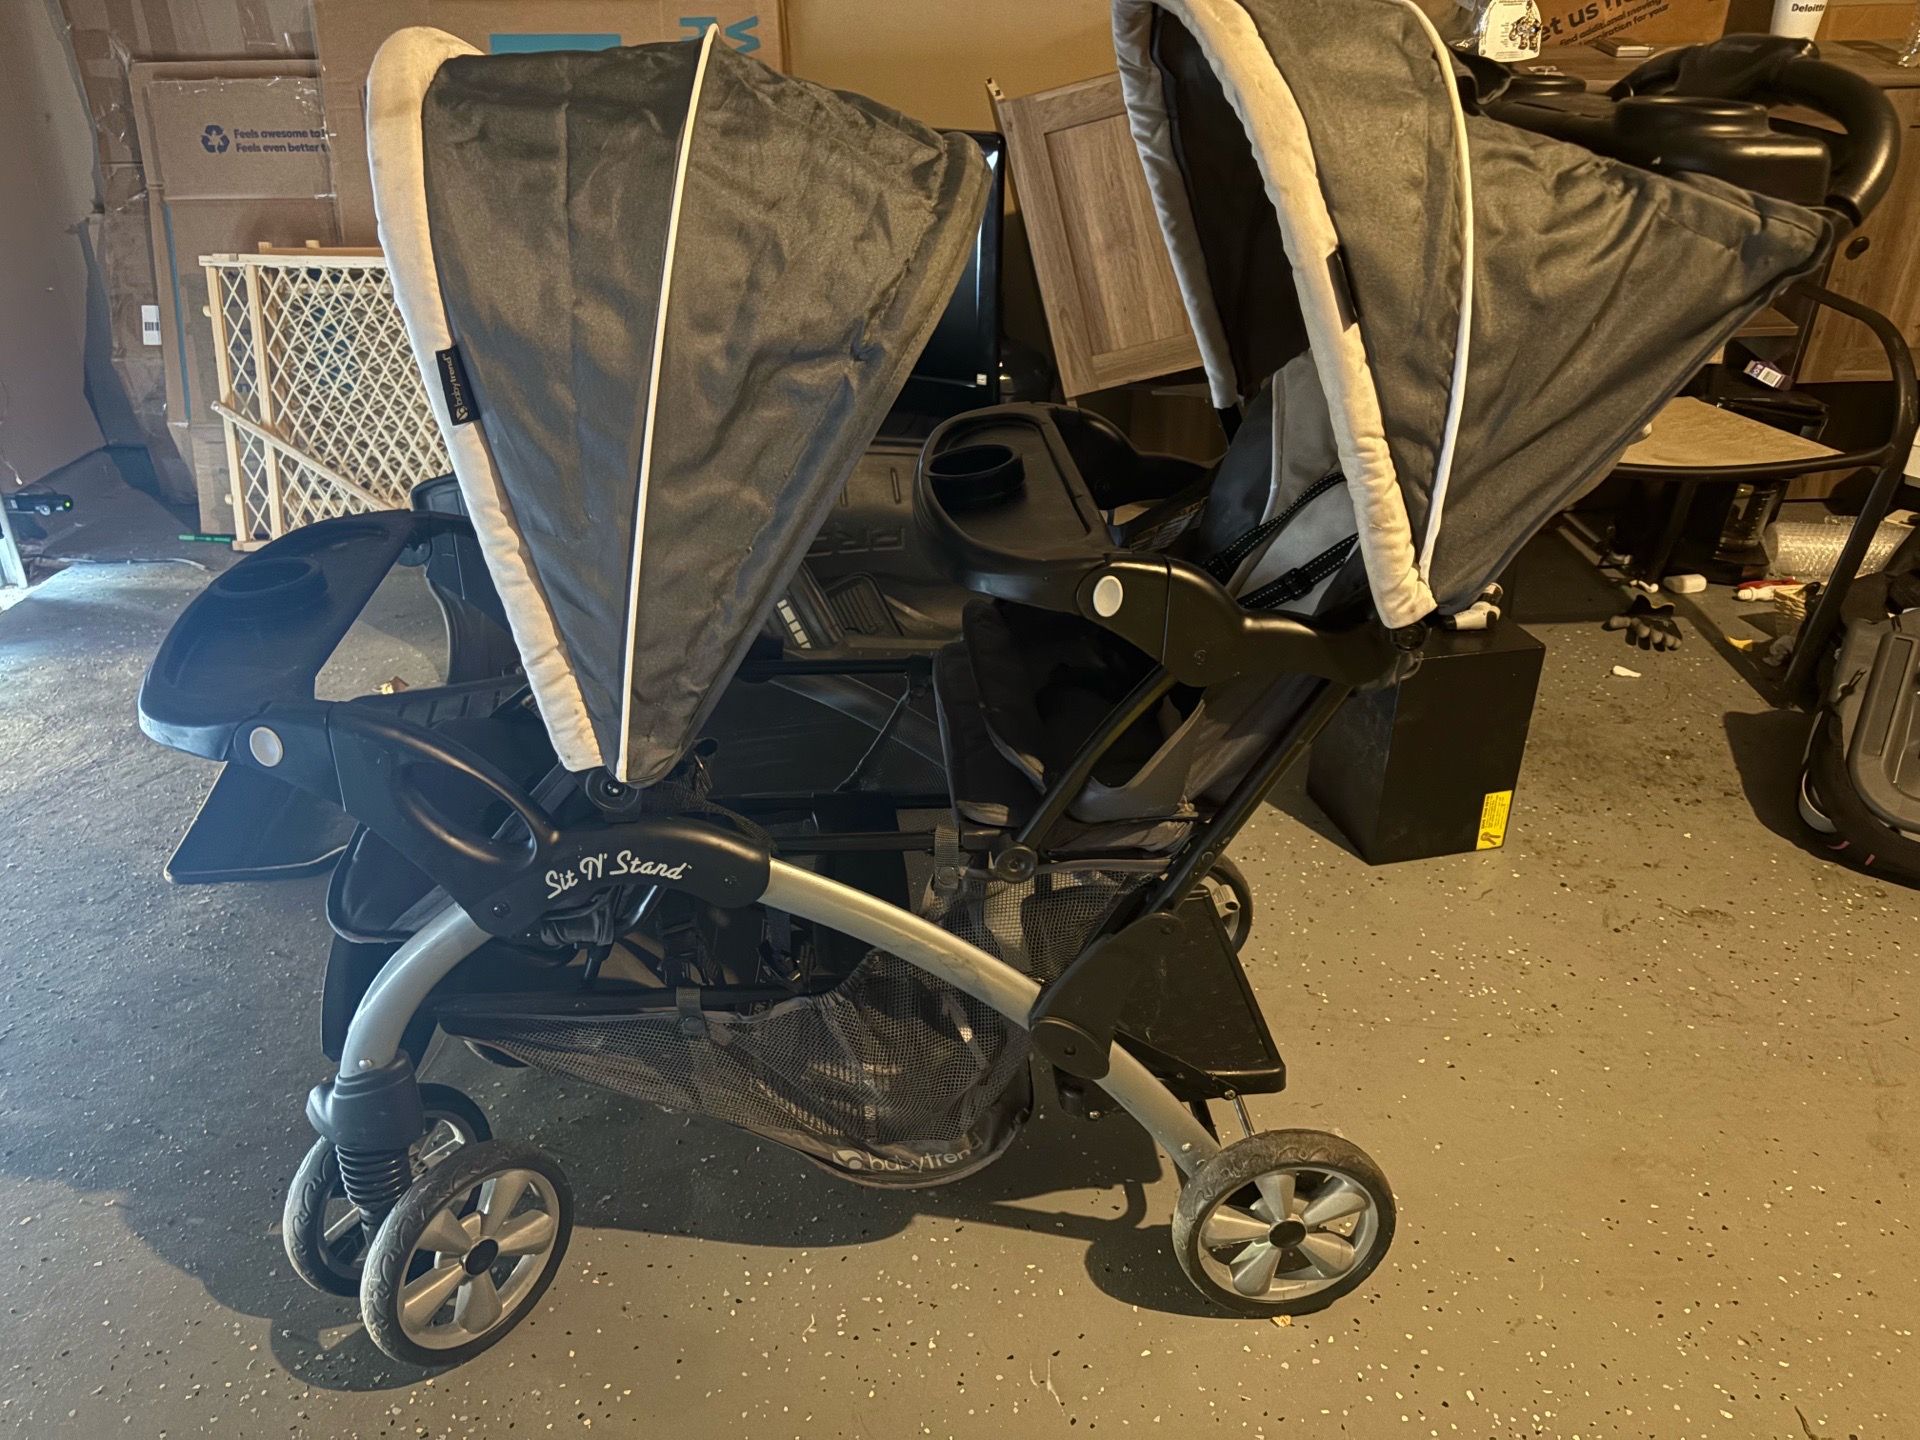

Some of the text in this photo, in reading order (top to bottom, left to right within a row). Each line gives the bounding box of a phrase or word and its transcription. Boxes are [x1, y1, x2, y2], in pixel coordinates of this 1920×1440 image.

[1540, 17, 1562, 43] et
[1568, 4, 1599, 28] us
[1579, 11, 1628, 39] additional
[1633, 13, 1647, 25] for
[1648, 4, 1669, 18] your
[234, 129, 259, 139] Feels
[261, 131, 308, 139] awesome
[310, 129, 320, 138] to
[236, 143, 261, 153] Feels
[263, 144, 287, 152] even
[288, 142, 319, 152] better
[442, 353, 463, 407] babytrend
[545, 870, 578, 899] Sit
[609, 850, 687, 880] Stand
